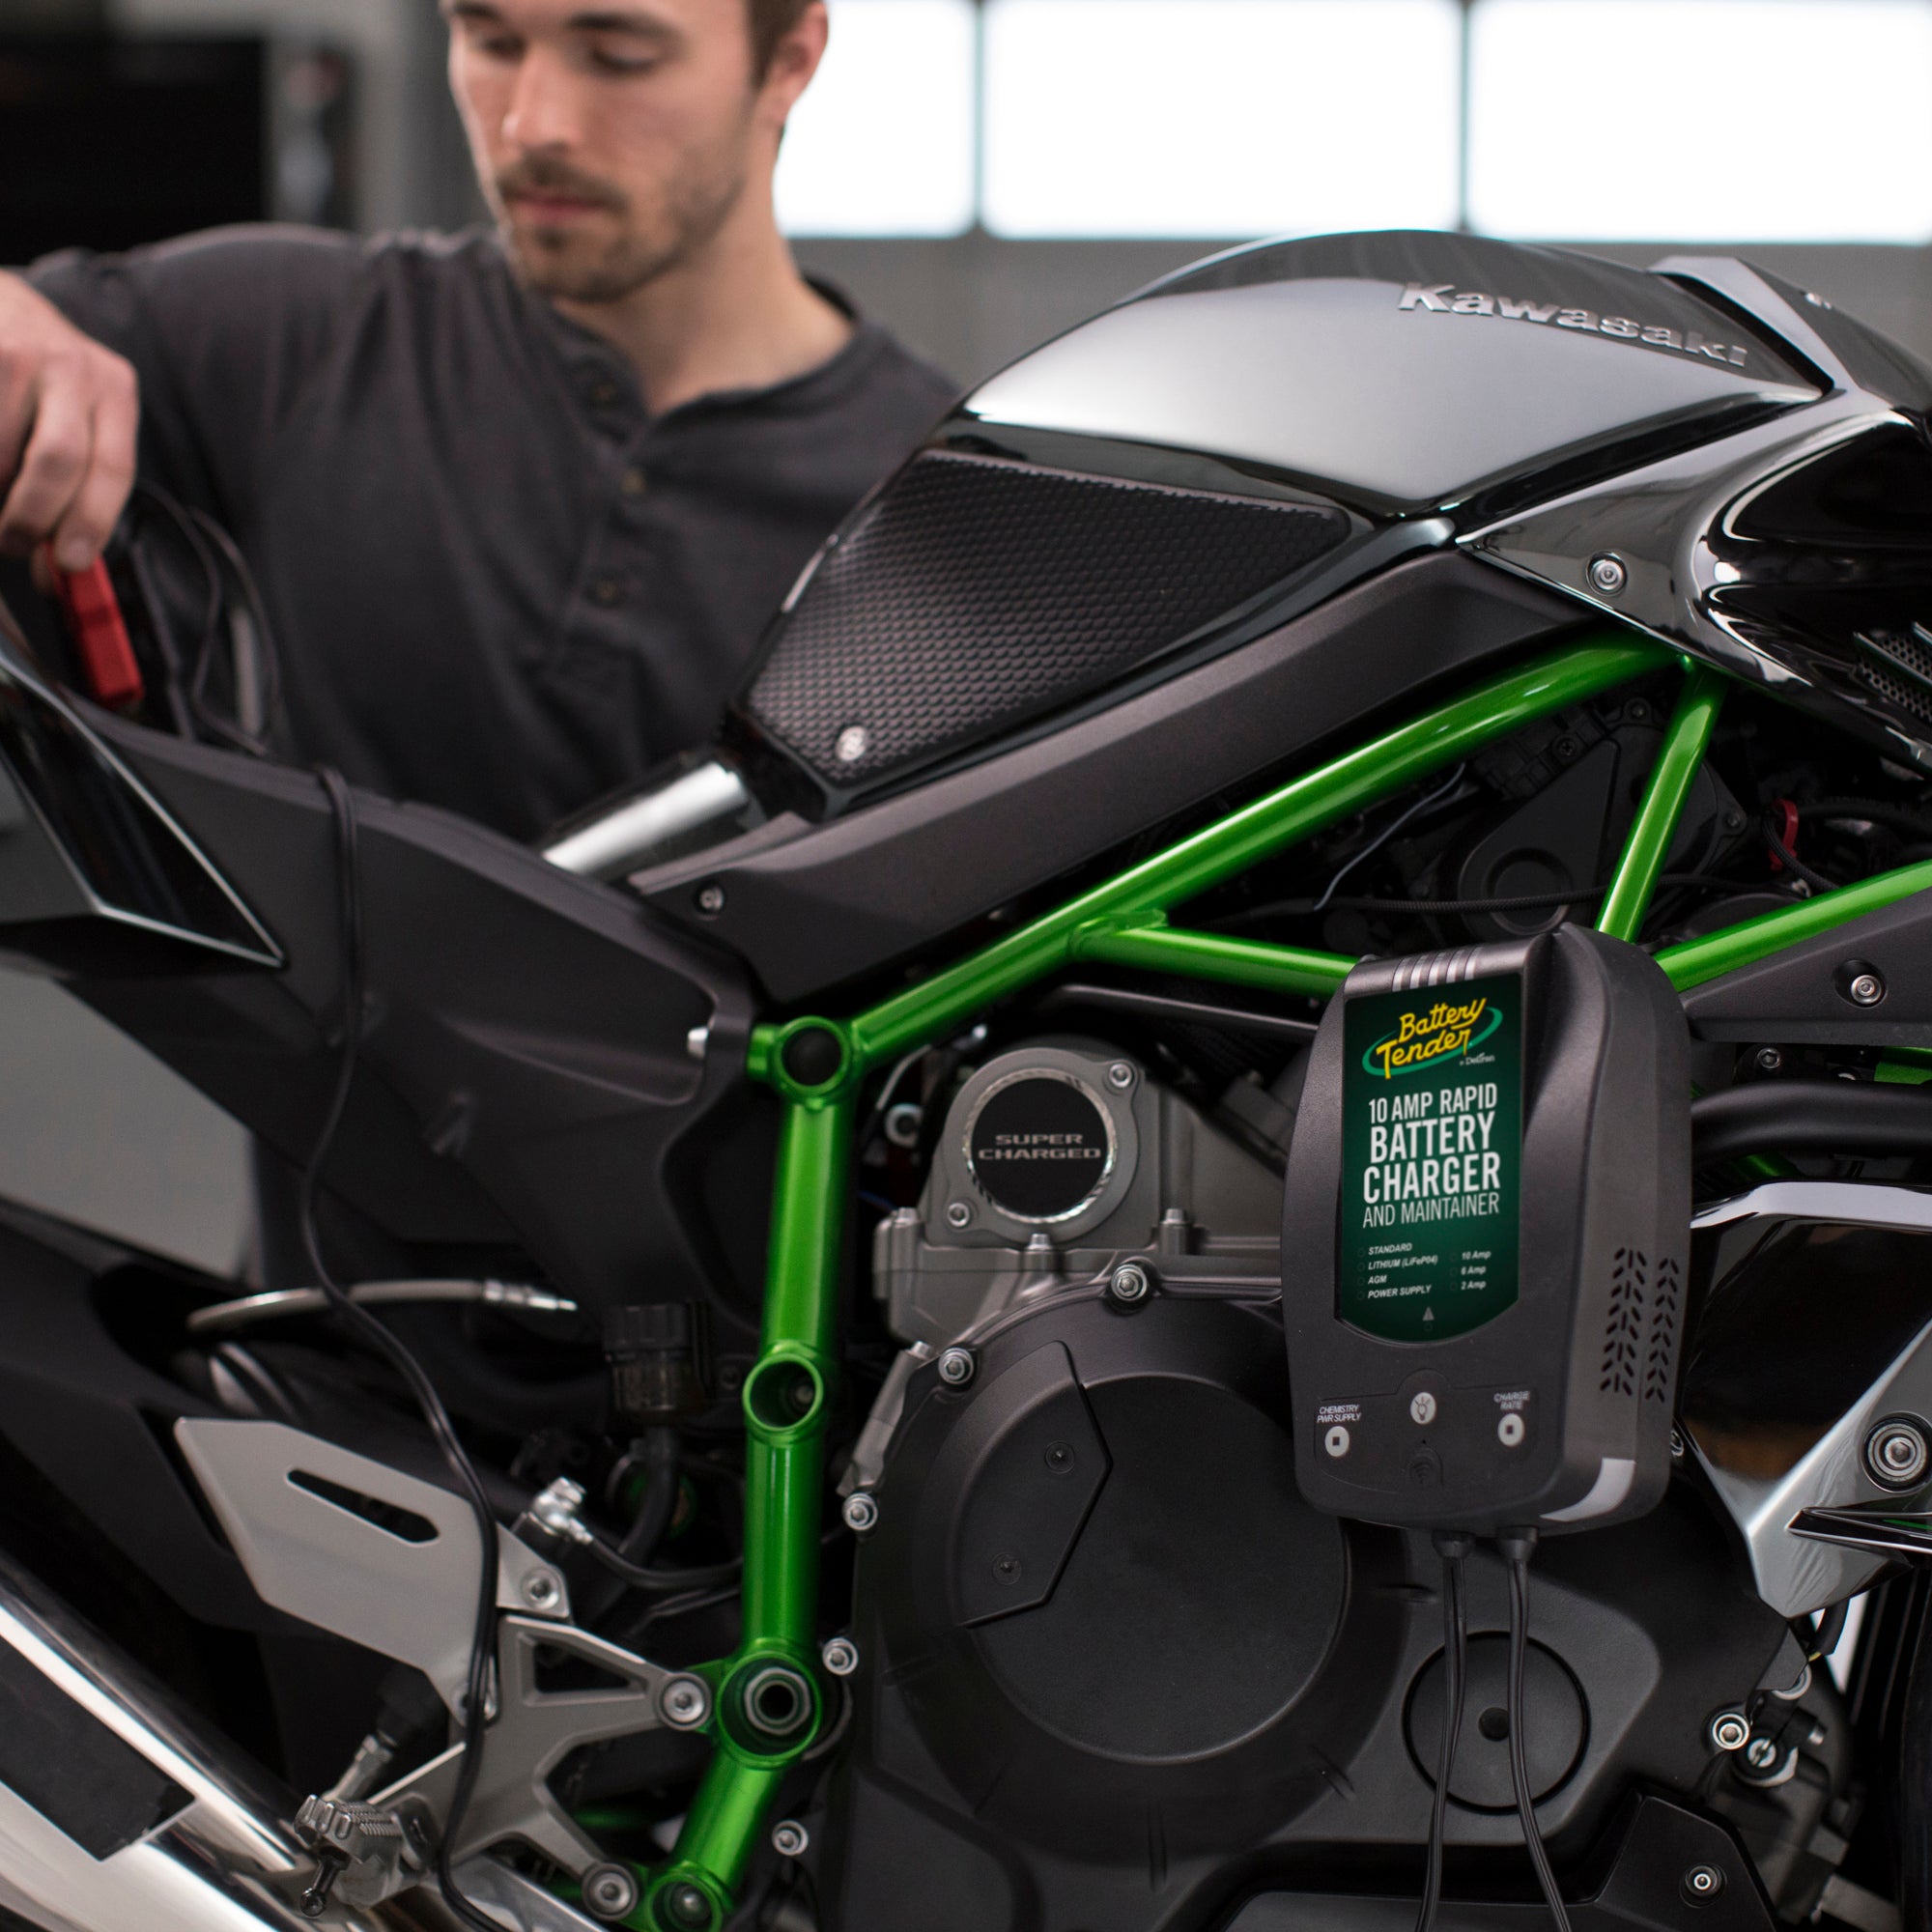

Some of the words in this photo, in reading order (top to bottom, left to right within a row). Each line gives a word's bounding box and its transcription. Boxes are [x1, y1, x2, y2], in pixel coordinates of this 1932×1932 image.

[1398, 284, 1748, 368] Kawasaki
[1399, 997, 1487, 1043] Battery
[1376, 1028, 1471, 1080] Tender
[1368, 1097, 1388, 1124] 10
[1391, 1092, 1434, 1122] AMP
[1440, 1082, 1498, 1116] RAPID
[995, 1133, 1083, 1145] SUPER
[1370, 1110, 1496, 1164] BATTERY
[978, 1148, 1101, 1160] CHARGED
[1363, 1151, 1501, 1205] CHARGER
[1362, 1204, 1396, 1229] AND
[1401, 1192, 1500, 1225] MAINTAINER
[1368, 1242, 1413, 1256] STANDARD
[1462, 1251, 1472, 1261] 10
[1473, 1250, 1492, 1261] Amp
[1368, 1259, 1401, 1270] LITHIUM
[1467, 1265, 1487, 1276] Amp
[1368, 1274, 1388, 1285] AGM
[1461, 1282, 1466, 1291] 2
[1467, 1280, 1487, 1291] Amp
[1368, 1287, 1398, 1299] POWER
[1400, 1284, 1432, 1296] SUPPLY
[1319, 1404, 1359, 1414] CHEMISTRY
[1317, 1414, 1333, 1423] PWR
[1334, 1412, 1361, 1423] SUPPLY
